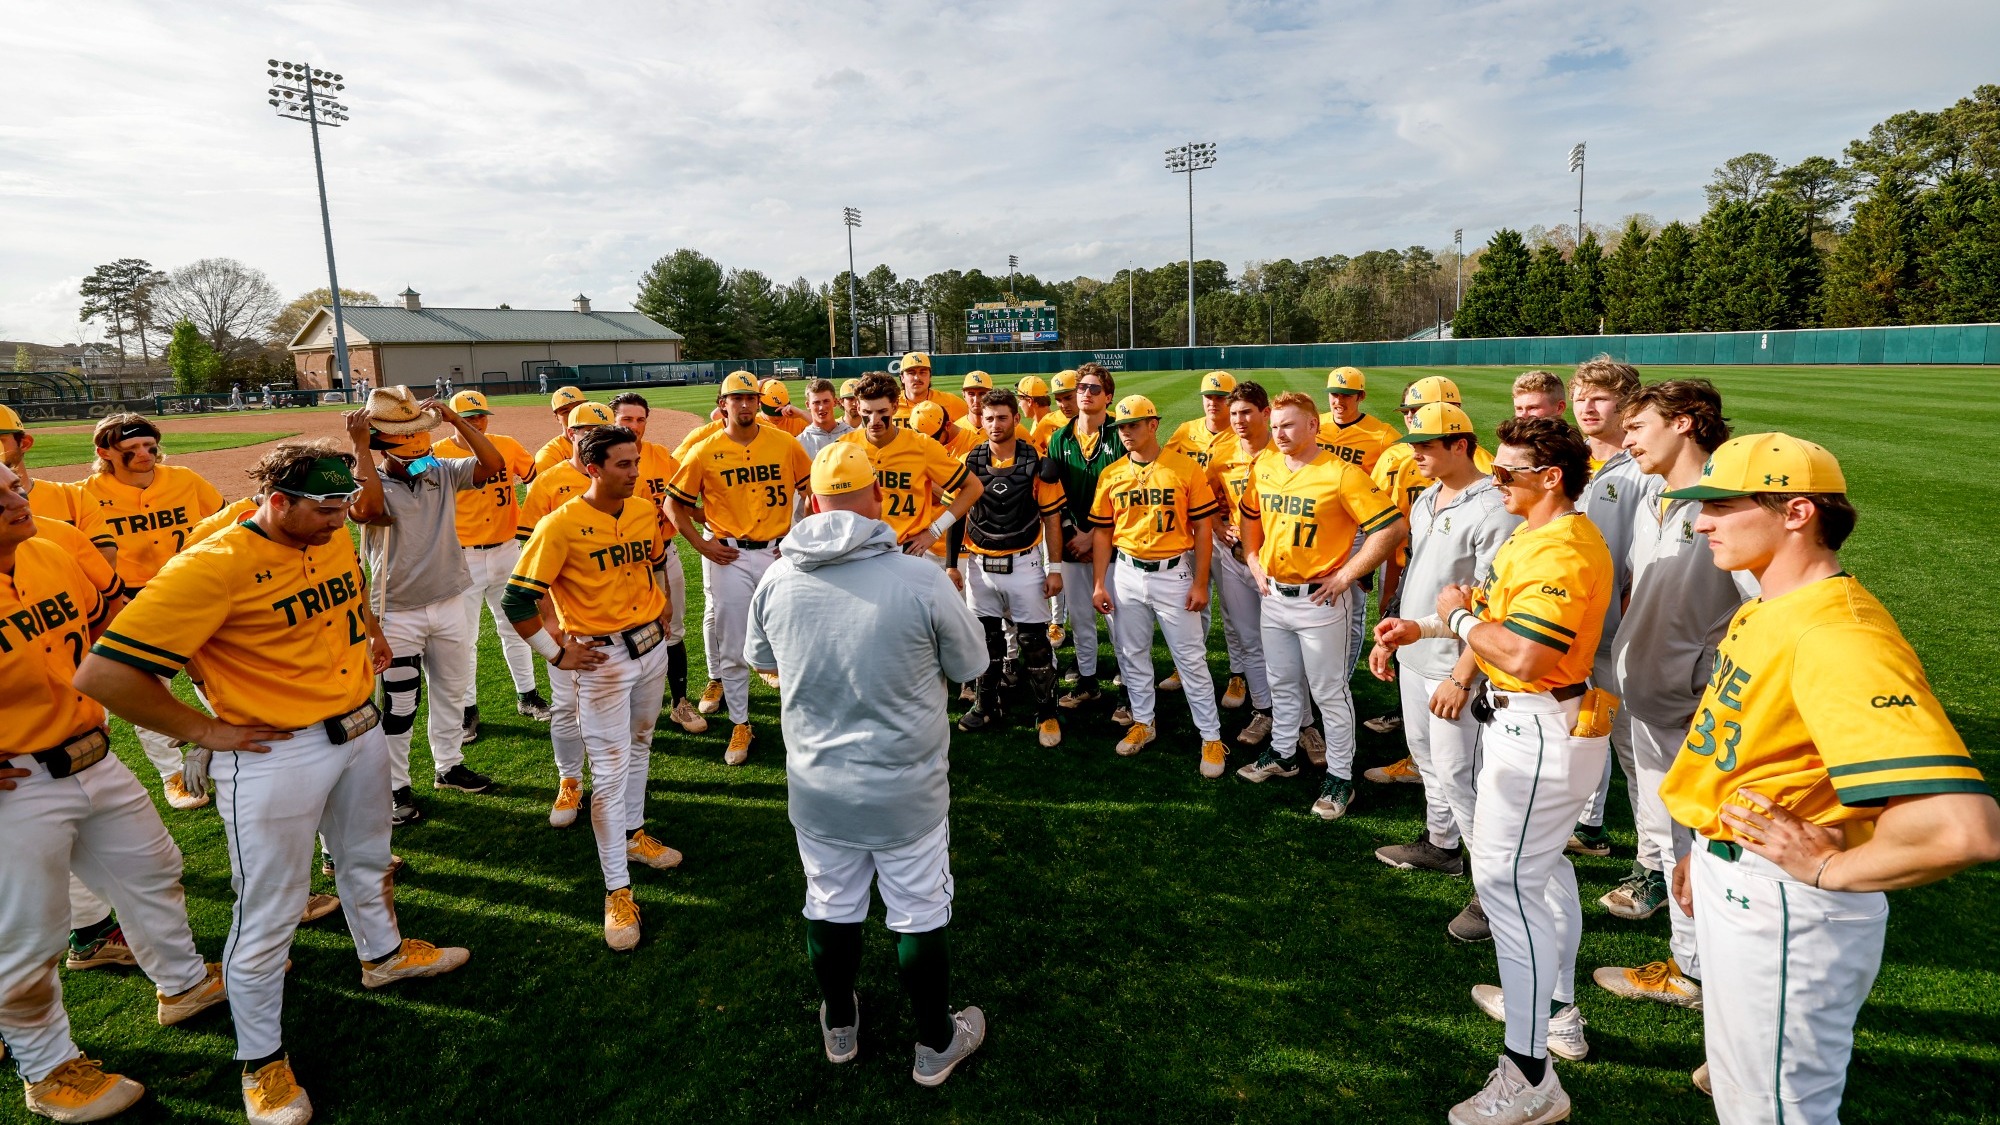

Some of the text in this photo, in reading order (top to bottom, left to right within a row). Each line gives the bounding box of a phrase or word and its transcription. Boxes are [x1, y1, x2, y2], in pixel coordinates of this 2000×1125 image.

[720, 463, 782, 487] TRIBE
[831, 481, 852, 491] TRIBE
[494, 485, 512, 507] 37
[765, 485, 788, 507] 35
[887, 493, 917, 517] 24
[1115, 488, 1175, 509] TRIBE
[1261, 493, 1317, 519] TRIBE
[105, 506, 188, 536] TRIBE
[1156, 509, 1176, 533] 12
[171, 526, 194, 554] 2
[1292, 521, 1318, 548] 17
[589, 539, 652, 572] TRIBE
[271, 571, 358, 627] TRIBE
[1541, 585, 1567, 598] CAA
[63, 624, 88, 670] 2
[1870, 694, 1918, 709] CAA
[1686, 707, 1742, 773] 33
